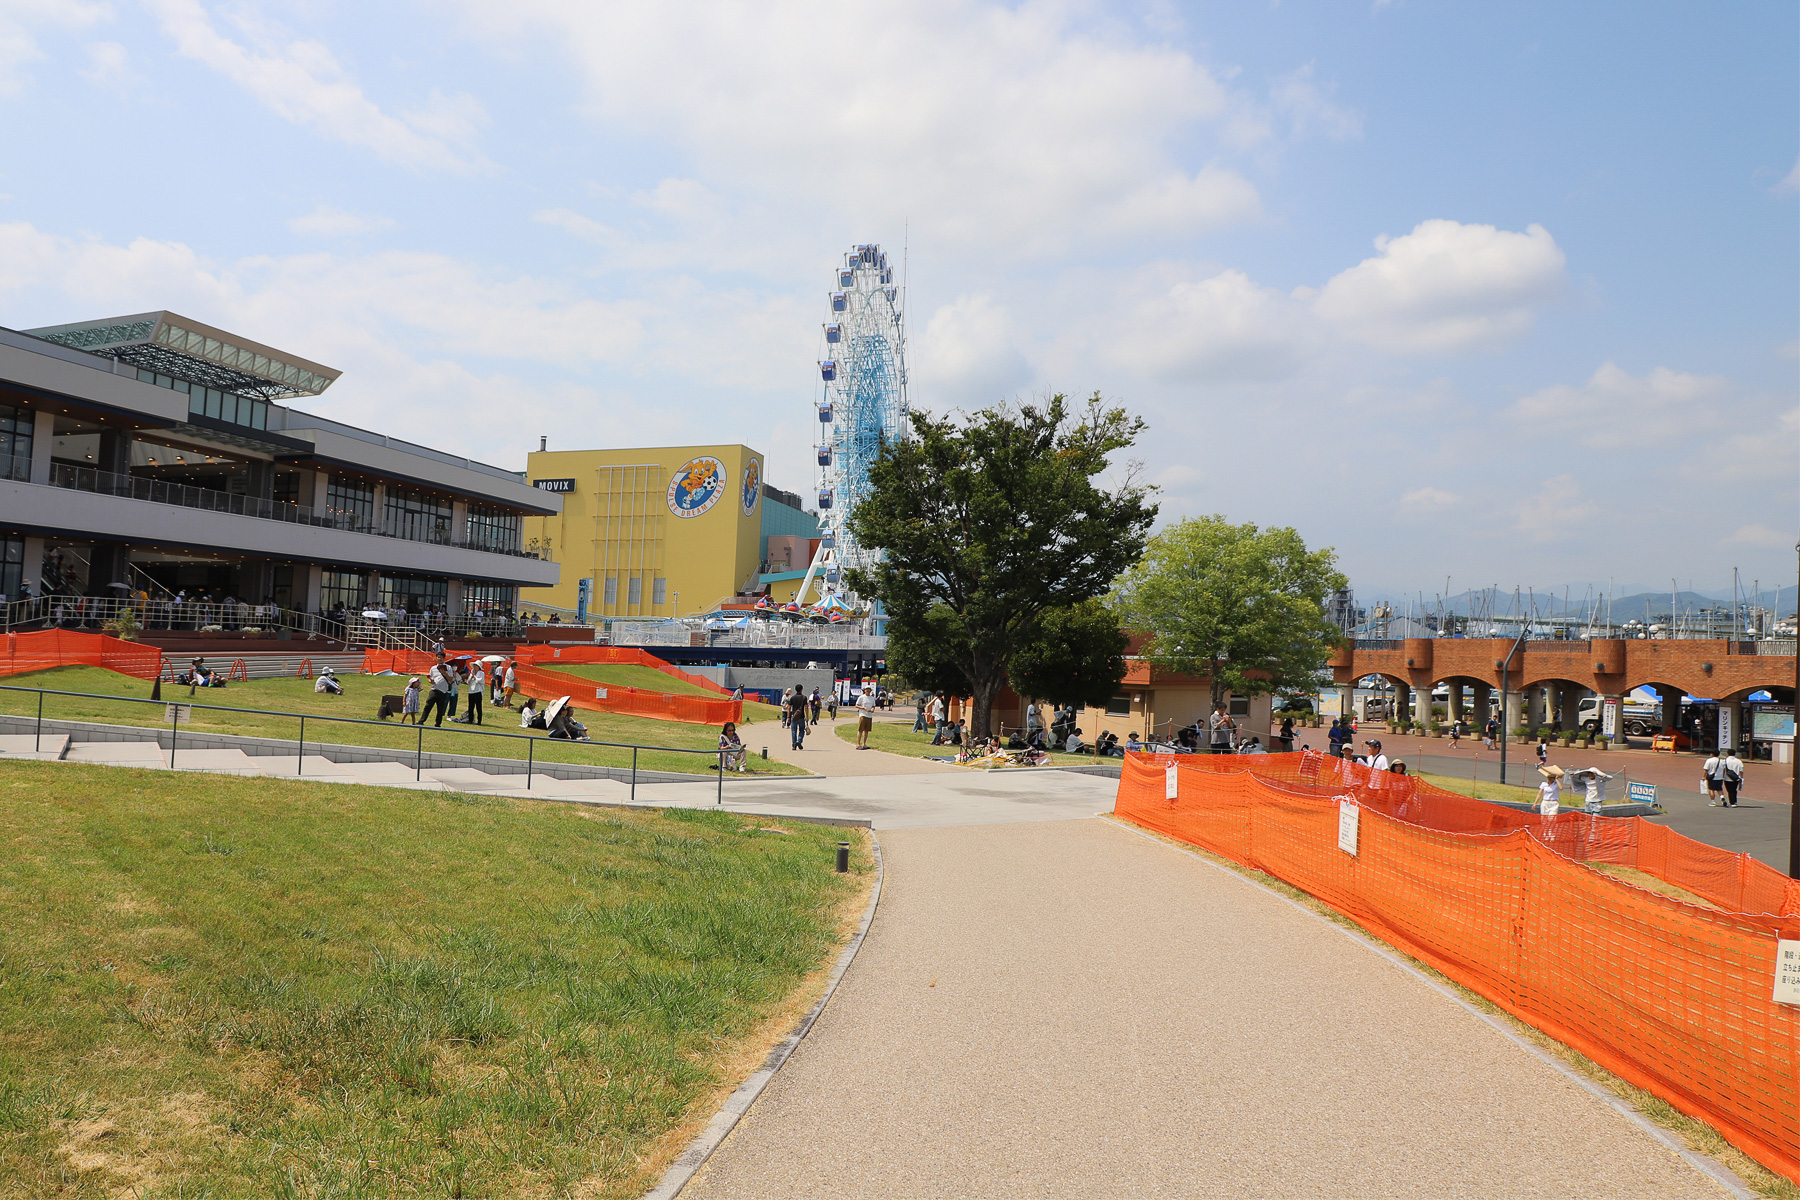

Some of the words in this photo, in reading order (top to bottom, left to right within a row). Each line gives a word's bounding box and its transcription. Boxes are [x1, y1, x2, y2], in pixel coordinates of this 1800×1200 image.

[538, 481, 569, 491] MOVIX
[680, 504, 708, 517] DREAM
[710, 479, 725, 504] PLAZA
